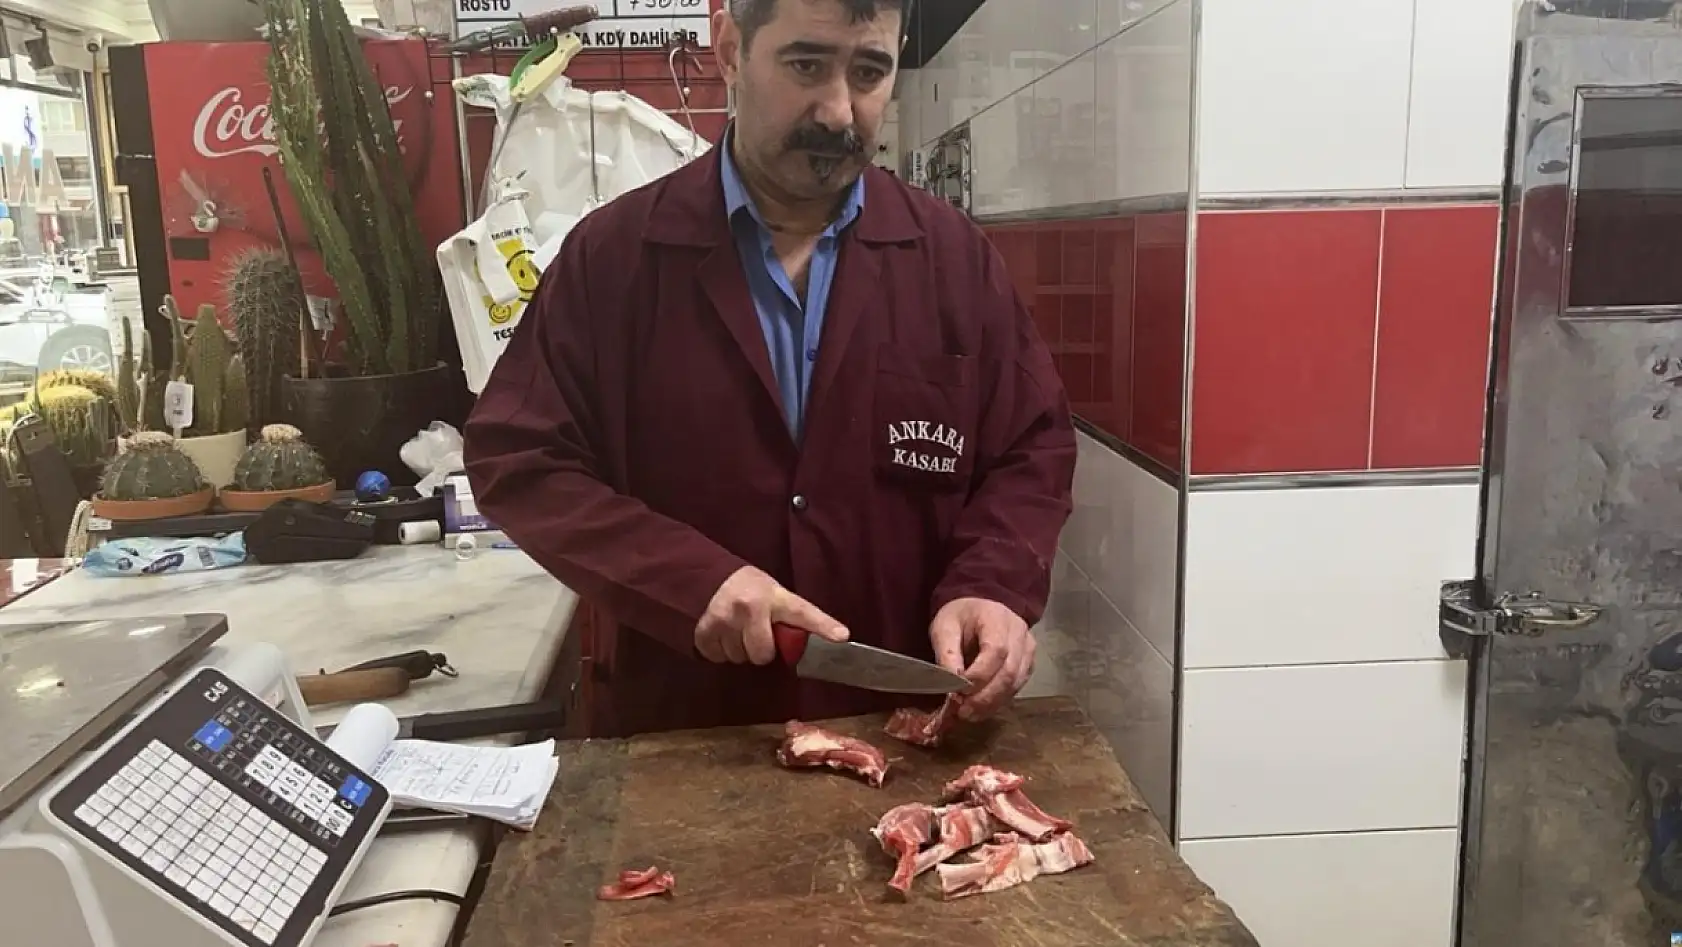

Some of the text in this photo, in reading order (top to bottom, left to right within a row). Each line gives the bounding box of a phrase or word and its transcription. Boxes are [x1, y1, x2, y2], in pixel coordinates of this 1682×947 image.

[459, 0, 511, 11] ROSTO
[596, 31, 625, 45] KDV
[888, 420, 965, 456] ANKARA
[892, 448, 958, 473] KASABI
[203, 681, 228, 702] CAS
[252, 768, 266, 779] 7
[269, 750, 282, 761] 9
[310, 793, 323, 803] 2
